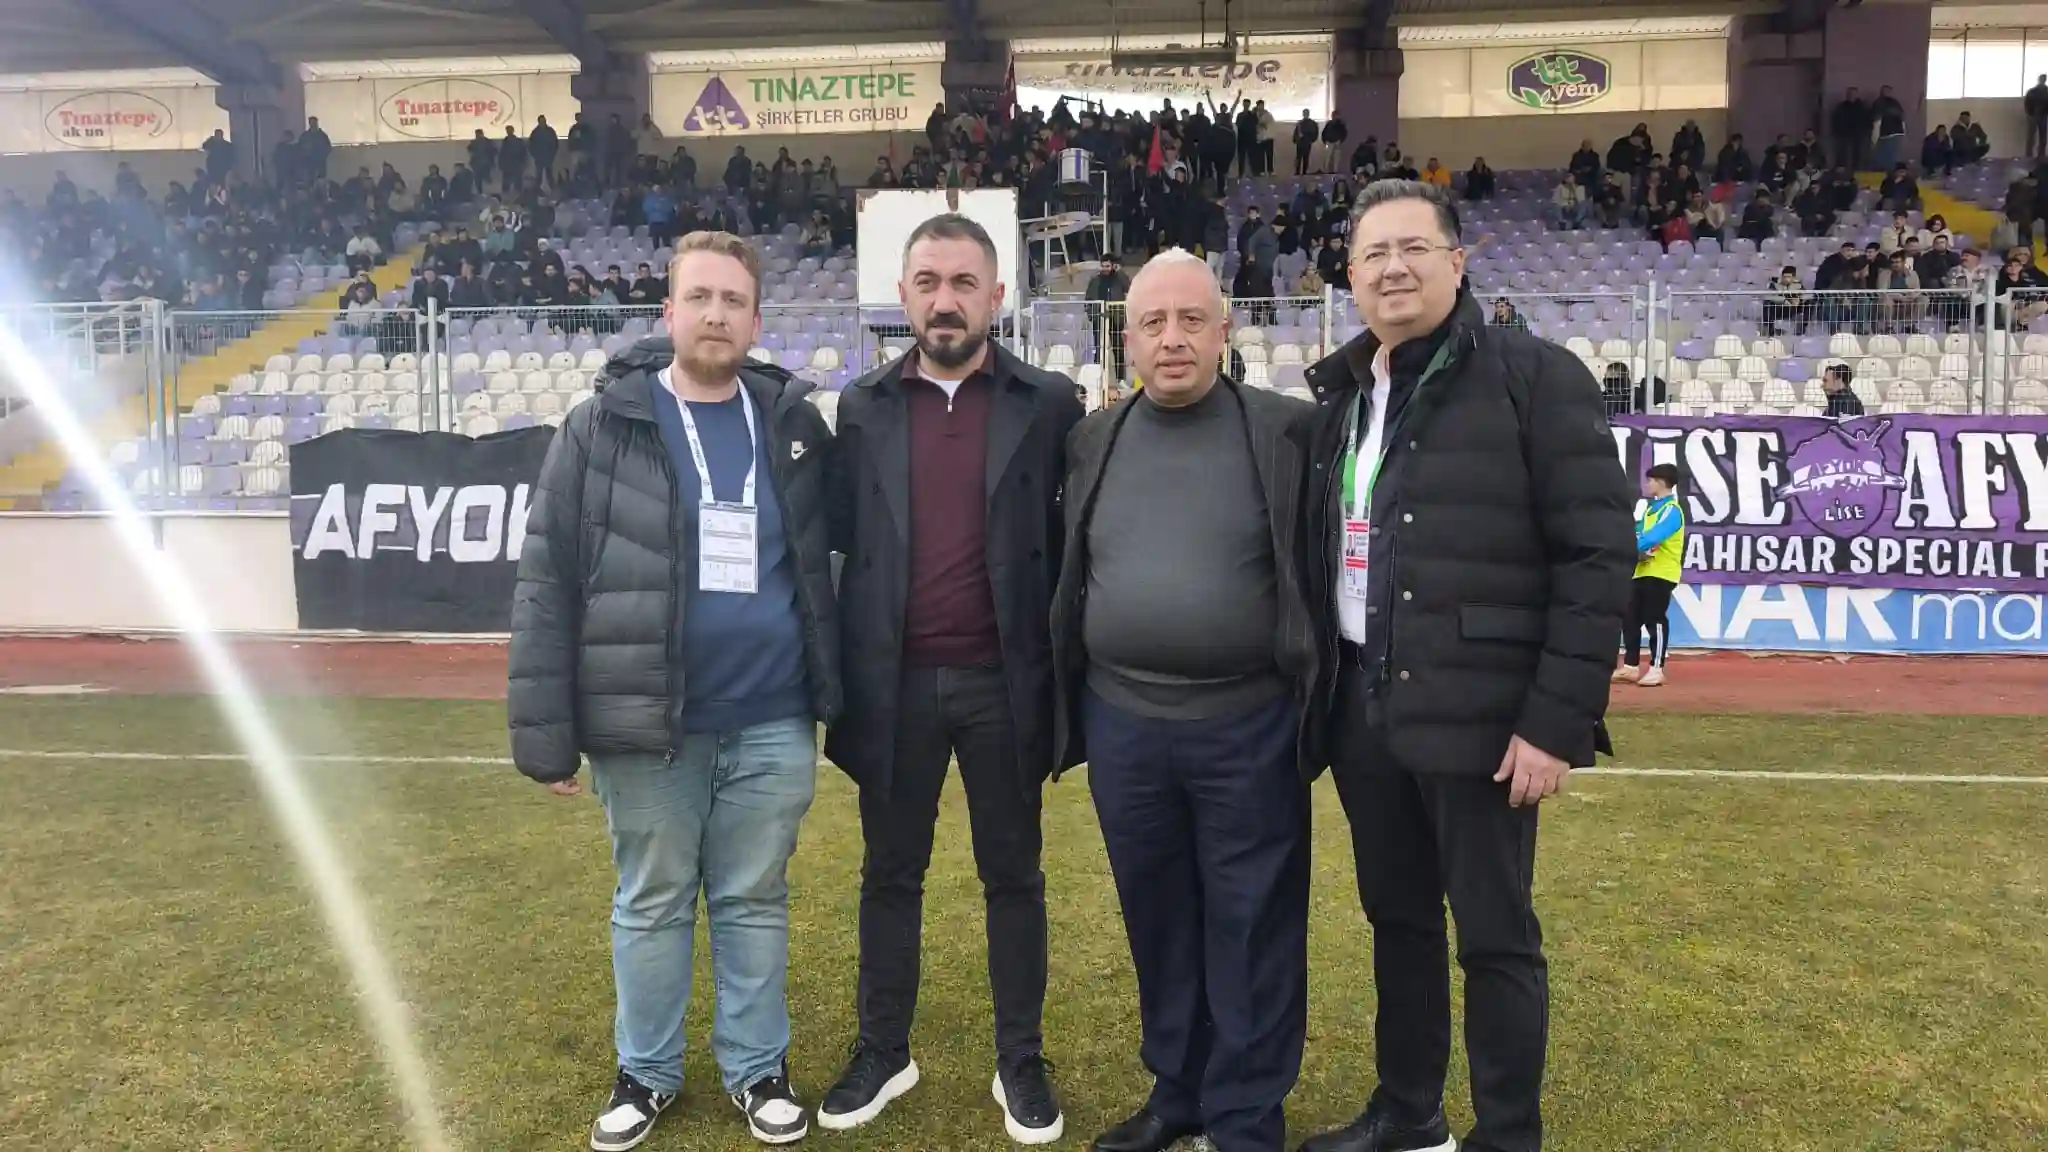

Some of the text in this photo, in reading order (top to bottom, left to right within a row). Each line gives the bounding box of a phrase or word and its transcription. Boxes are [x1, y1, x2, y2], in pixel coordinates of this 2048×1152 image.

[748, 73, 916, 103] TINAZTEPE
[1551, 83, 1600, 101] yem
[399, 117, 419, 126] un
[756, 106, 908, 128] ŞİRKETLER GRUBU
[62, 126, 104, 137] ak un
[1850, 536, 2021, 578] SPECIAL
